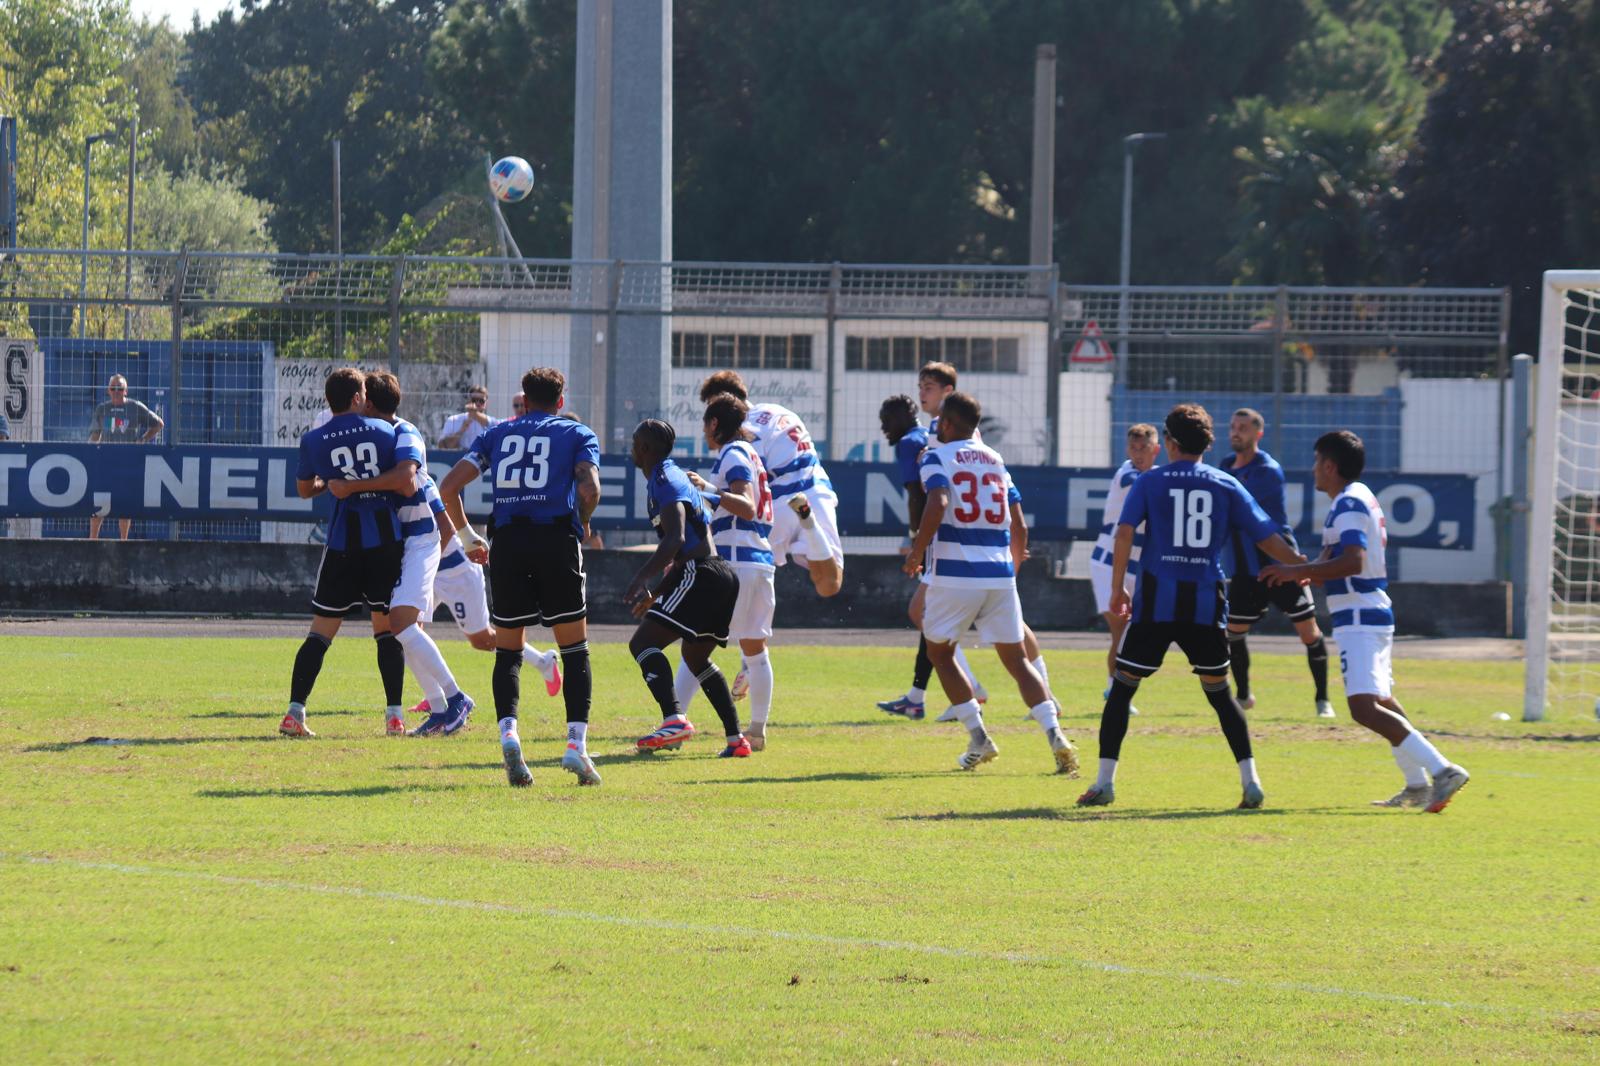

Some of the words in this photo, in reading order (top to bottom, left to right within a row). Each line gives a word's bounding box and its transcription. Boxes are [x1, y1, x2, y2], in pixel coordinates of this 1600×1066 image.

[322, 425, 377, 440] WORKNESS
[143, 454, 313, 511] NEL
[330, 442, 381, 481] 33
[496, 434, 551, 489] 23
[952, 471, 1006, 525] 33
[1168, 488, 1213, 549] 18
[454, 602, 466, 619] 9
